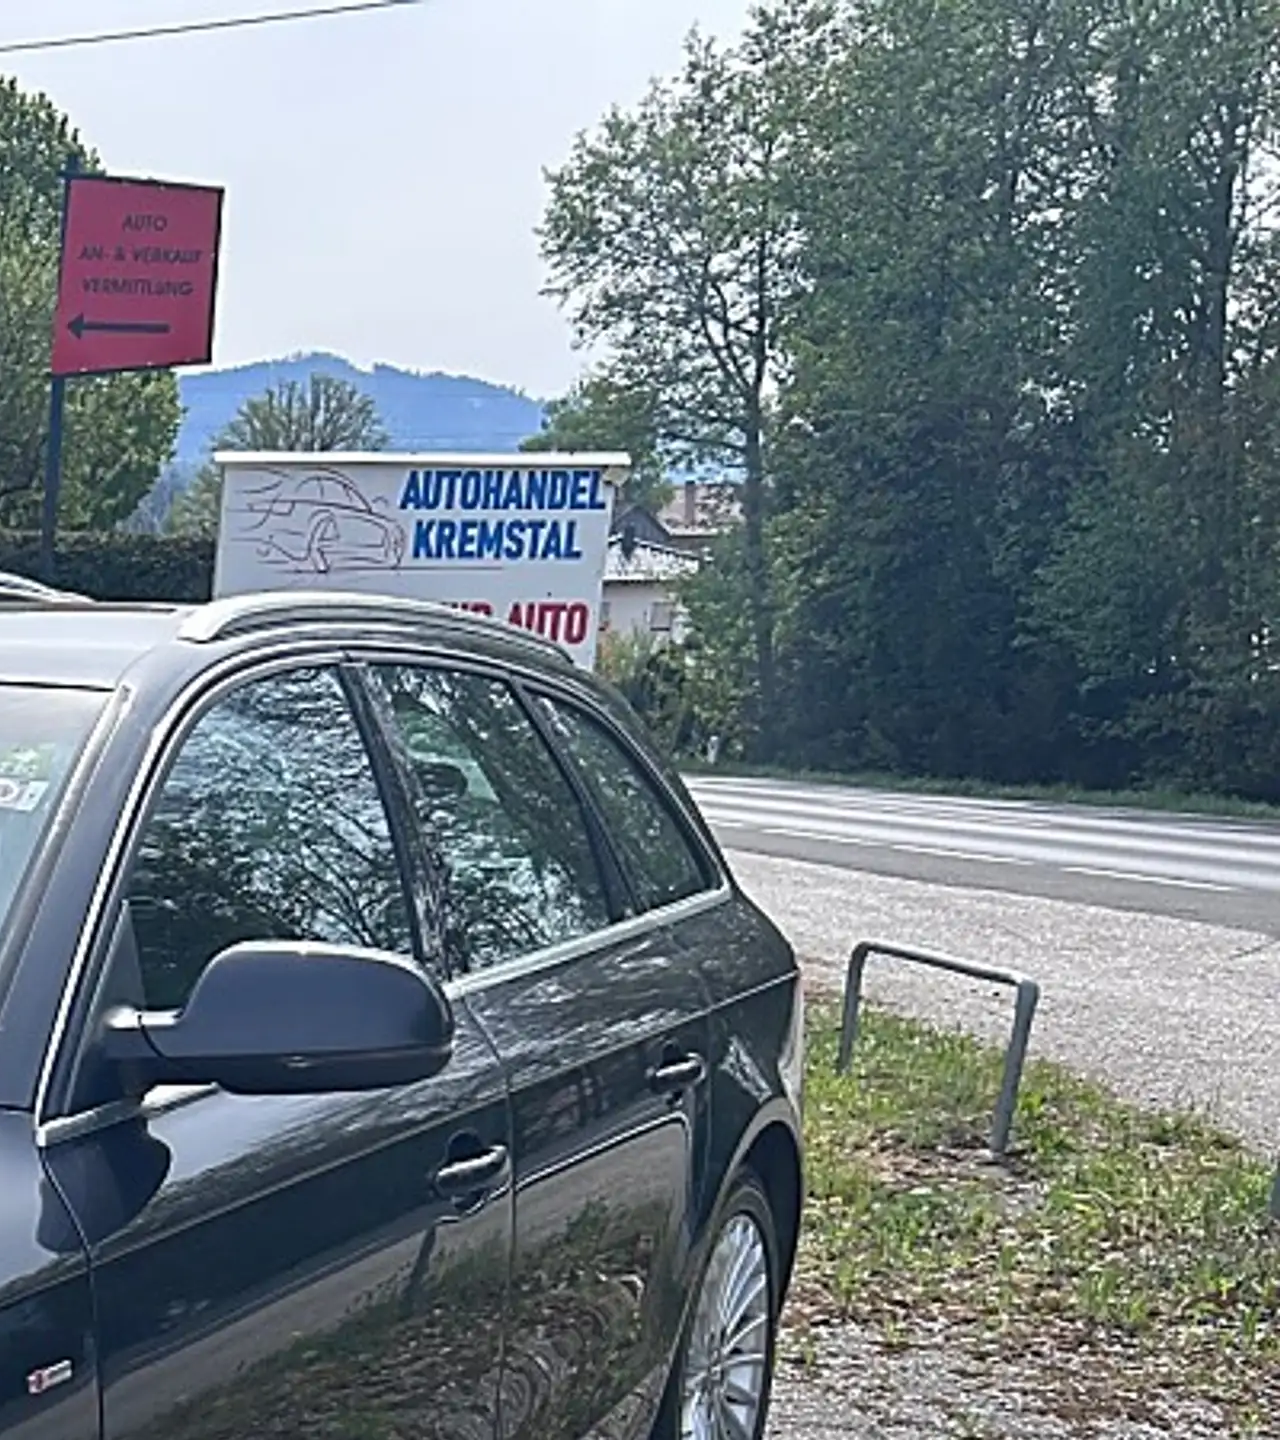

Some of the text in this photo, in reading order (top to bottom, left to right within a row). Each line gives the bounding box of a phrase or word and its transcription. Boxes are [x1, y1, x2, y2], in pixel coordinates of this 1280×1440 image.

[122, 214, 168, 232] AUTO
[133, 248, 204, 264] VERKAUF
[83, 278, 194, 296] VERMITTLUNG
[399, 469, 608, 511] AUTOHANDEL
[412, 519, 582, 560] KREMSTAL
[508, 602, 589, 645] AUTO
